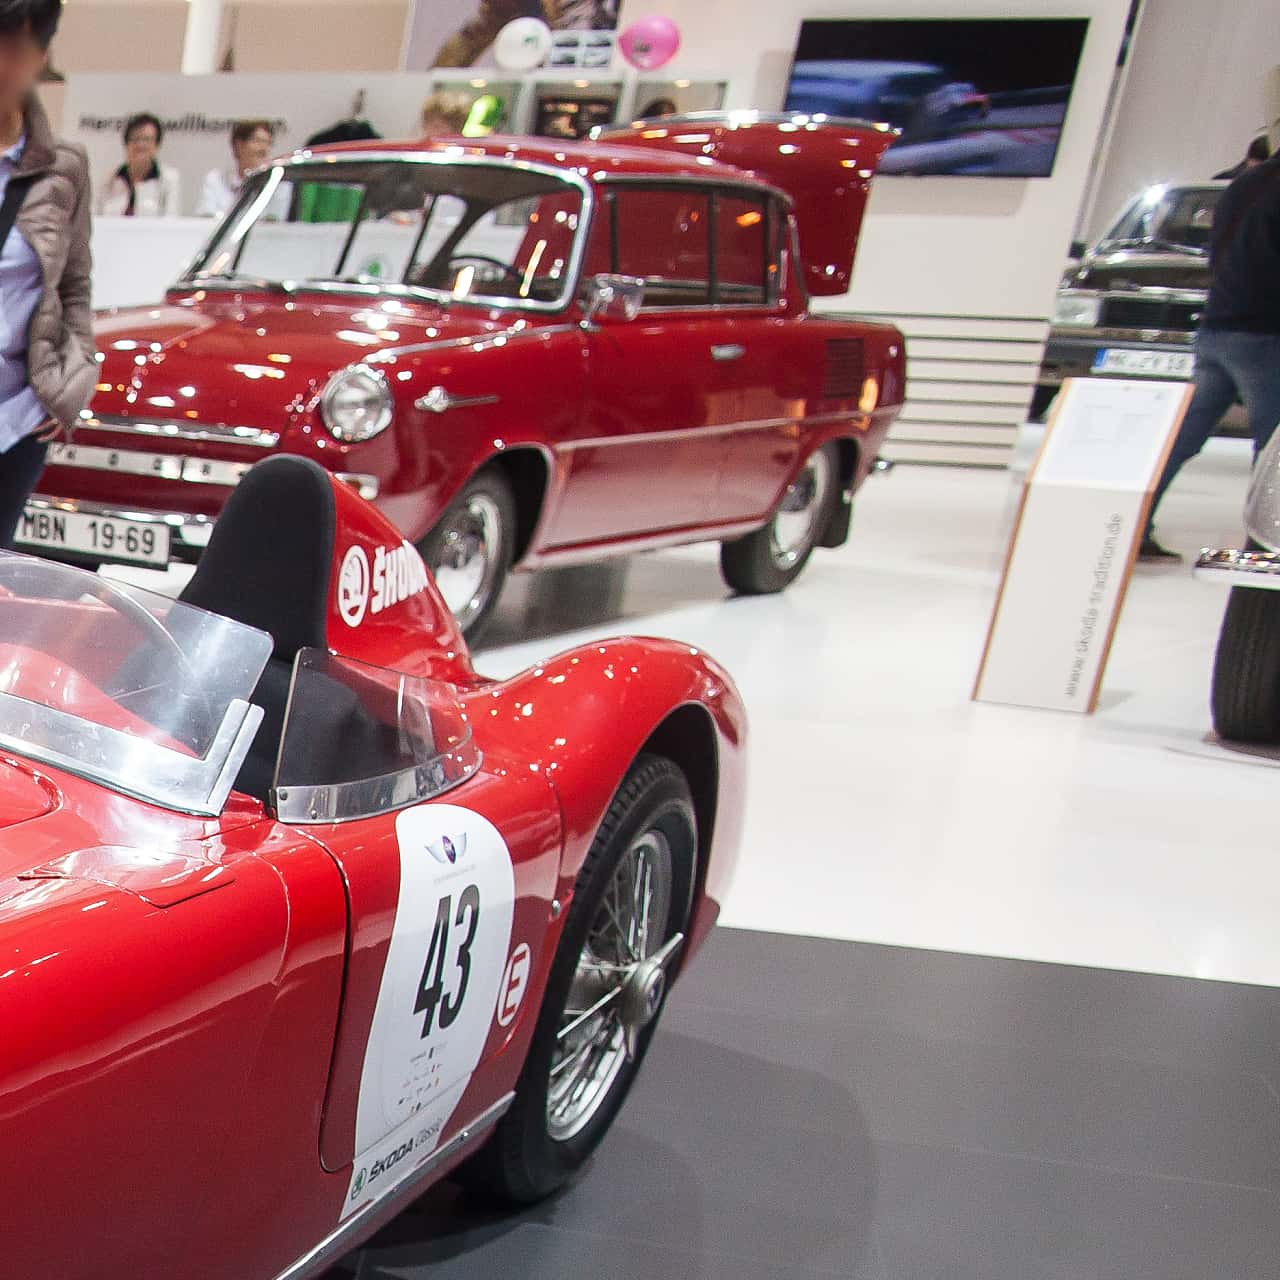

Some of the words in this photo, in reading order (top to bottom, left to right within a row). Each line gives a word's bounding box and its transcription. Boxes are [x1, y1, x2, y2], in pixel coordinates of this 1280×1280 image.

[23, 511, 66, 542] MBN
[88, 520, 155, 554] 19-69
[413, 884, 480, 1040] 43
[501, 949, 527, 1019] E
